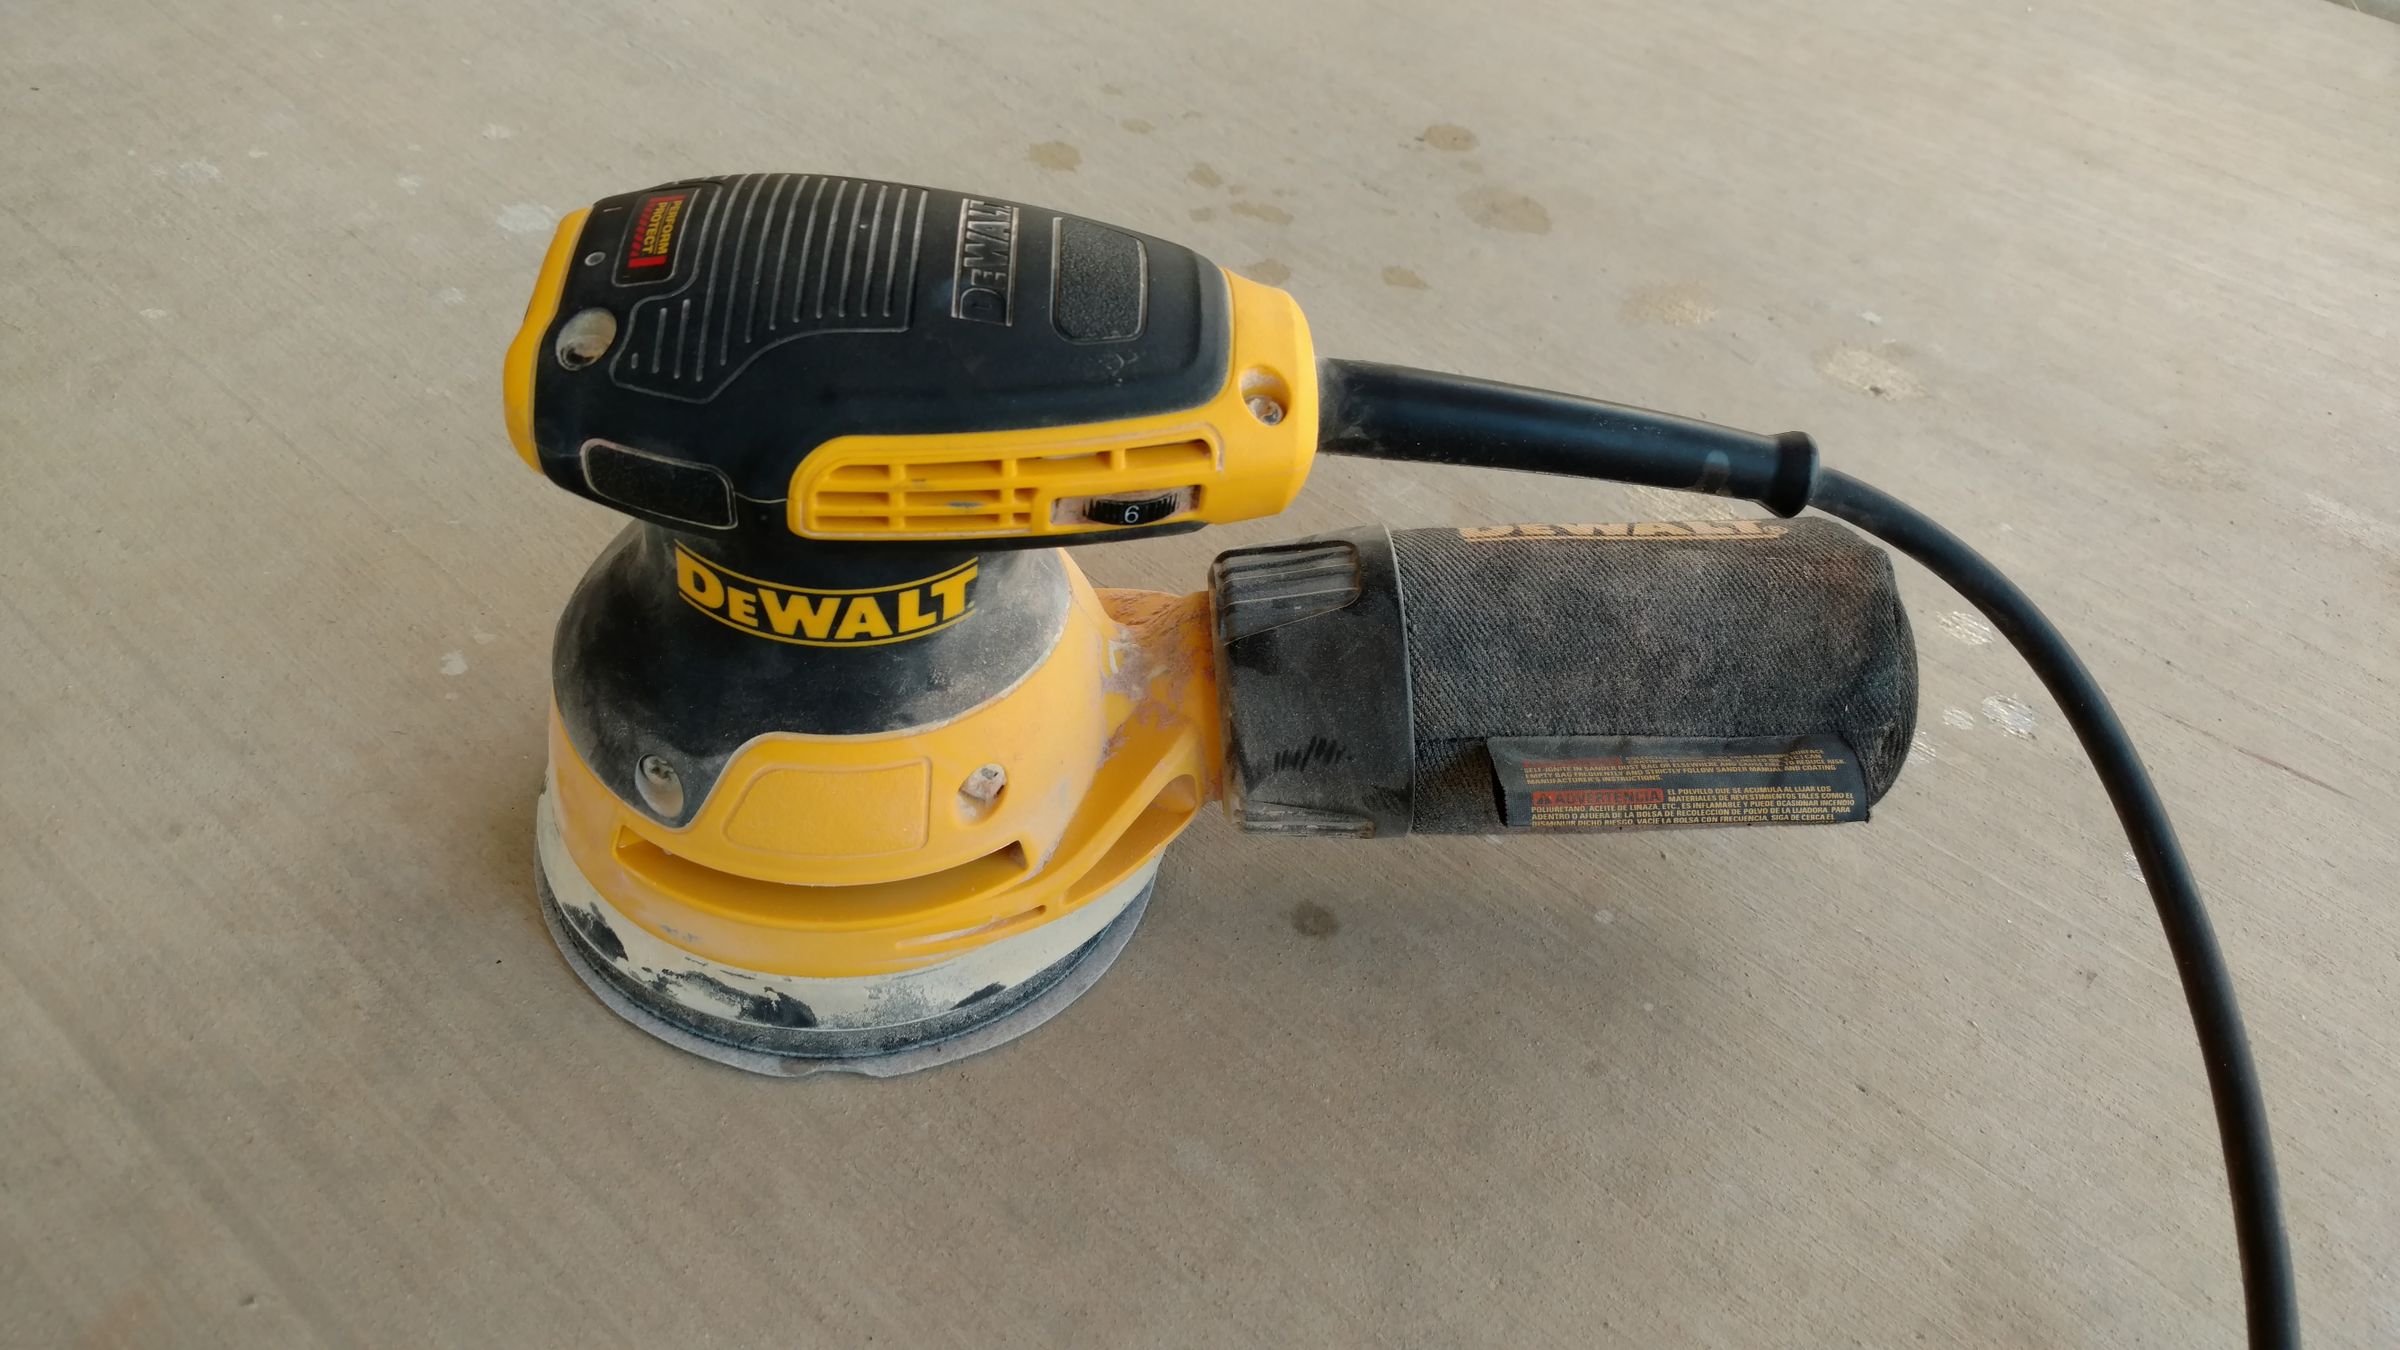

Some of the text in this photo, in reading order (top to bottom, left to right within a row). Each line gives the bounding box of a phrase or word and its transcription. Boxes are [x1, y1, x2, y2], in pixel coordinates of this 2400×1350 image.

[641, 201, 669, 255] PROTECT
[656, 200, 683, 255] PERFORM
[1124, 505, 1140, 524] 6
[674, 547, 978, 640] DEWALT
